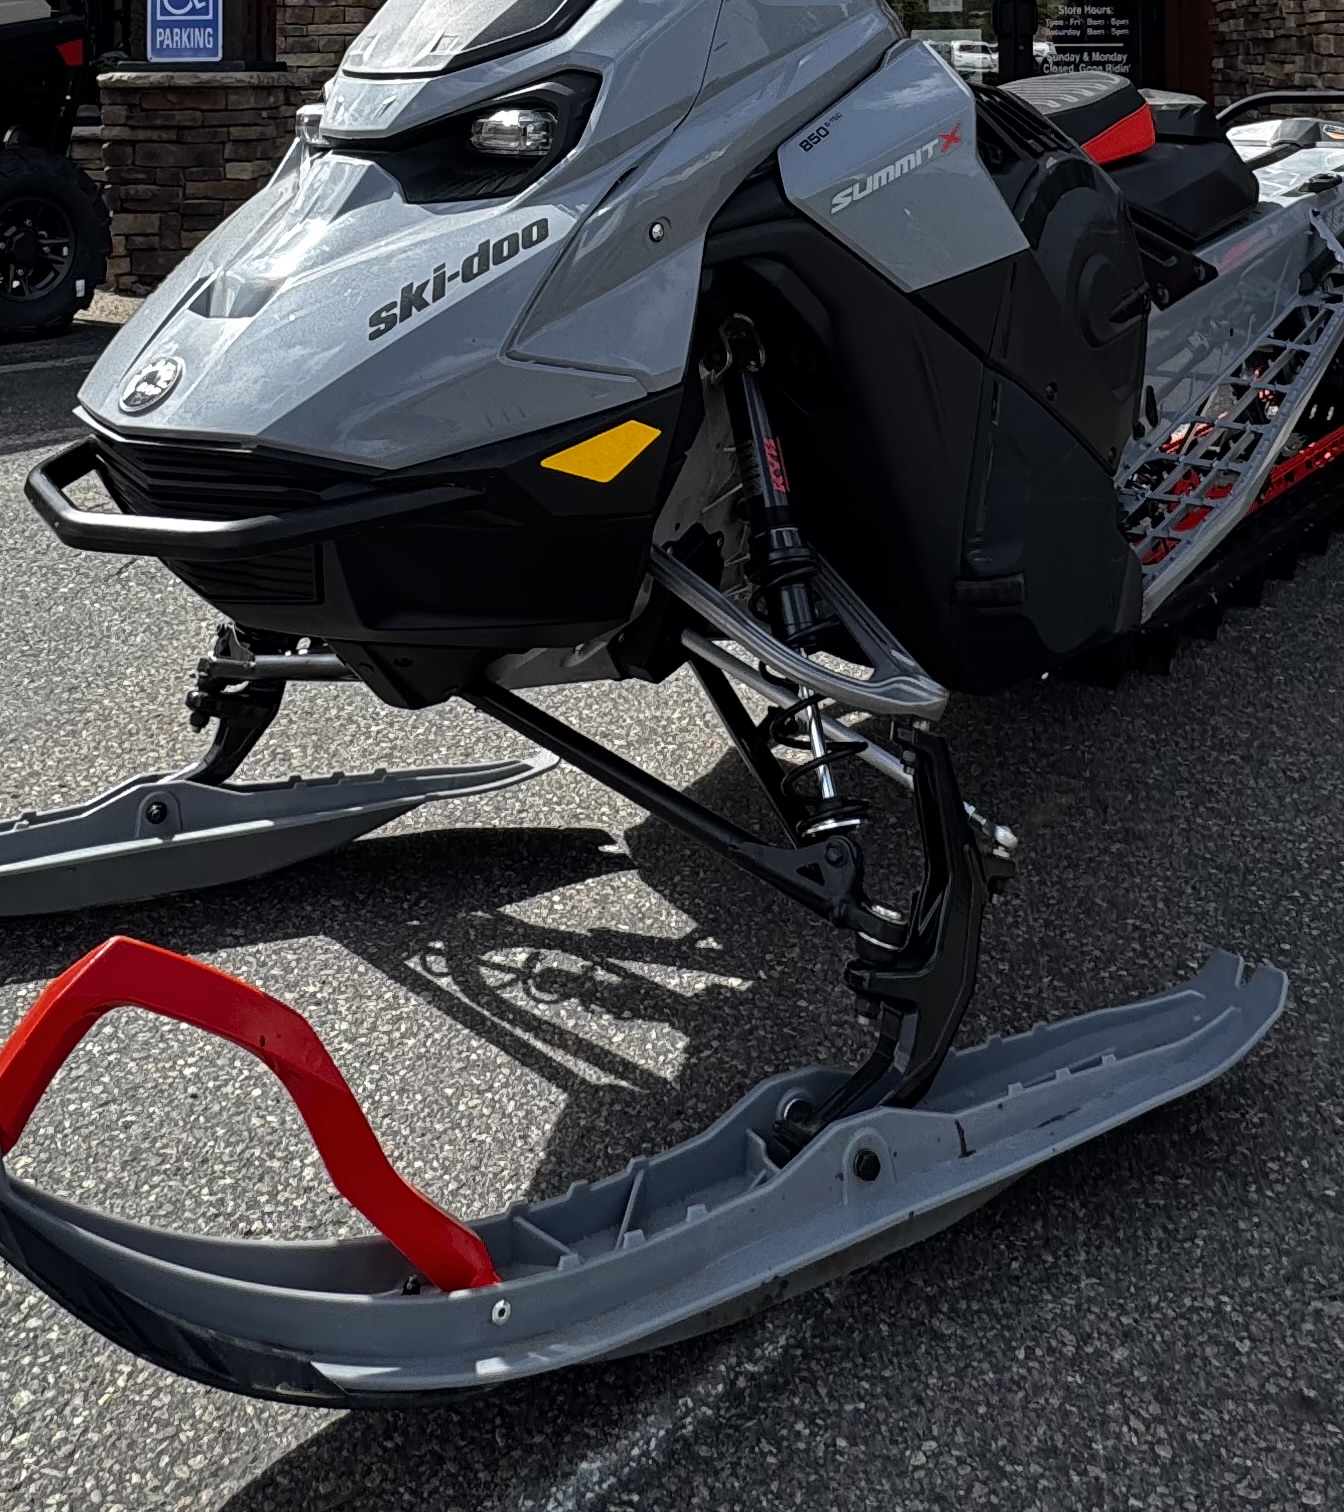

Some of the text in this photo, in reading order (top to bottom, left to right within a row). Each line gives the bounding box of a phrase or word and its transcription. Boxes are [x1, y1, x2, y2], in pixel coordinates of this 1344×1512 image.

[156, 27, 213, 49] PARKING
[1046, 52, 1081, 63] Sunday
[1092, 51, 1128, 64] Monday
[799, 125, 830, 152] 850
[830, 137, 939, 215] SUMMIT
[368, 217, 549, 341] ski-doo
